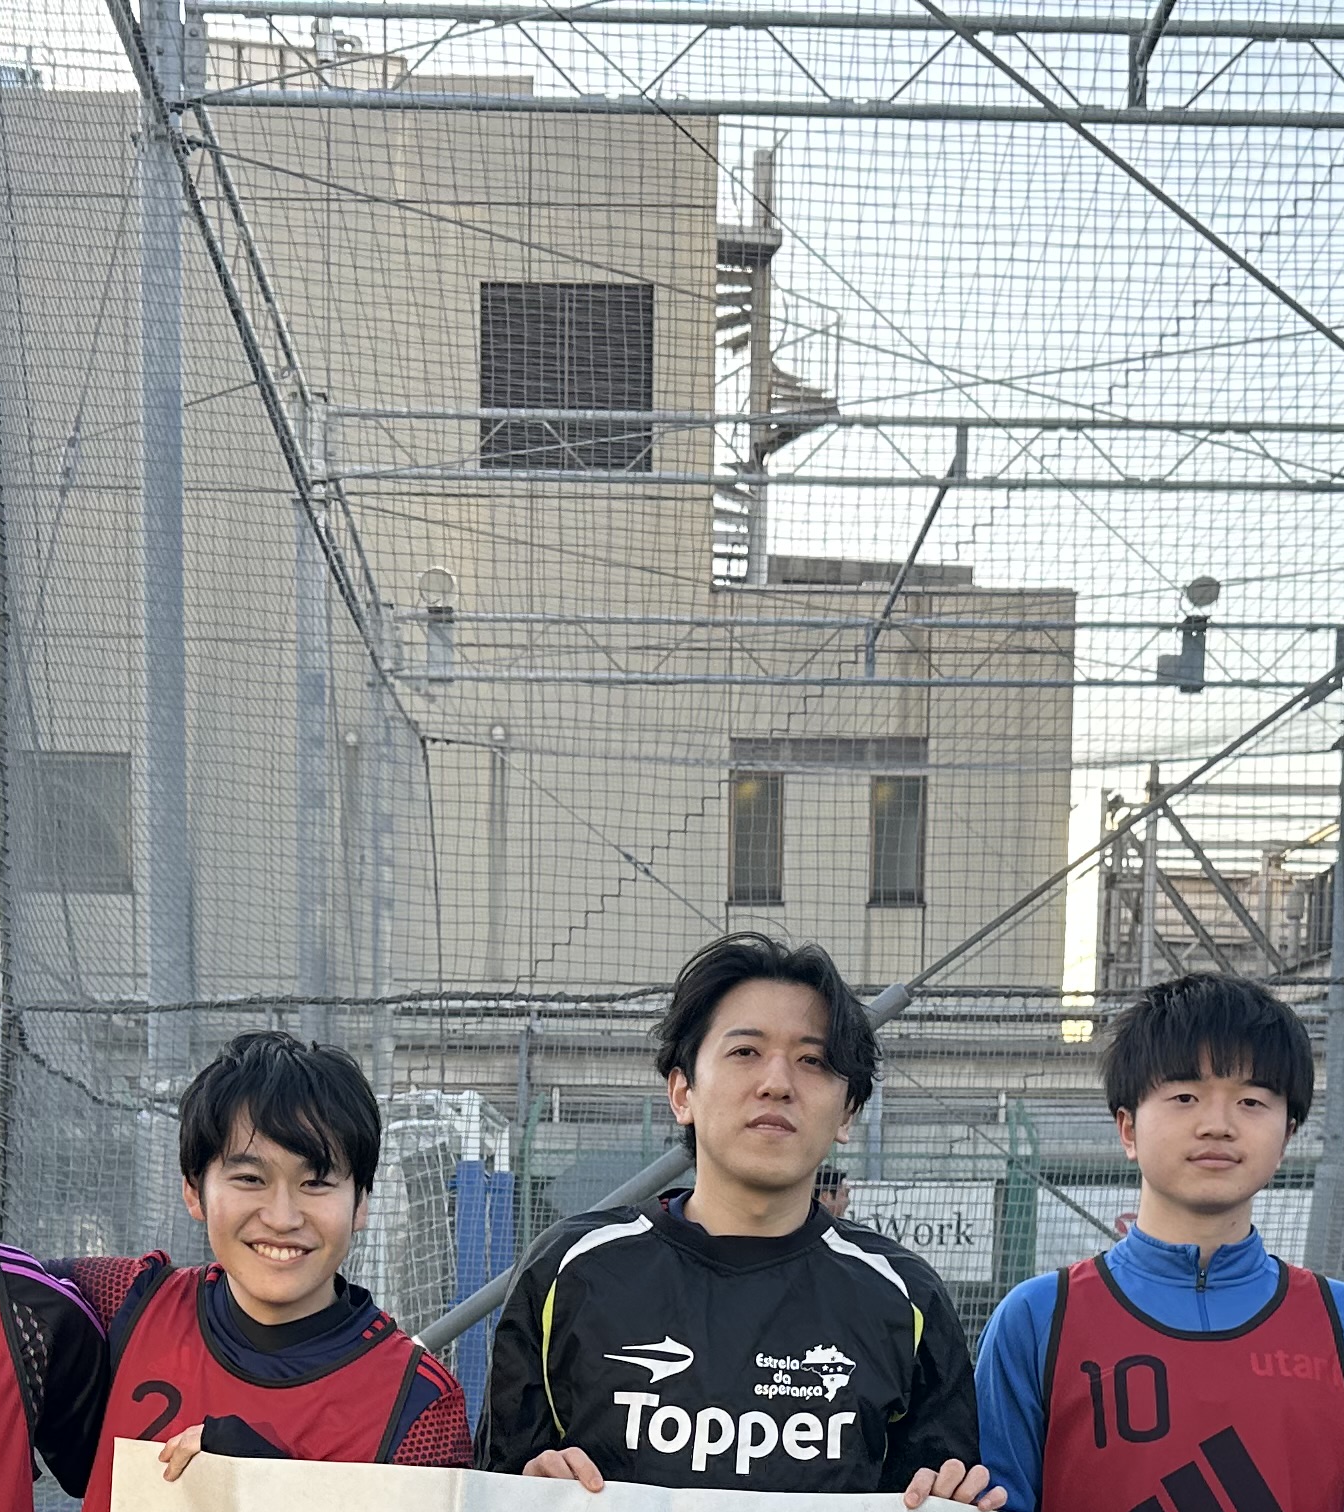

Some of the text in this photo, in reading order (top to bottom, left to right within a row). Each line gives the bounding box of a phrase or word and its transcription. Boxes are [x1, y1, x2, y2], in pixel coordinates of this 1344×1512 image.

[755, 1352, 800, 1371] Estrela
[773, 1369, 792, 1385] da
[131, 1379, 183, 1442] 2
[754, 1383, 823, 1401] esperança
[1079, 1353, 1171, 1449] 10
[613, 1391, 857, 1475] Topper
